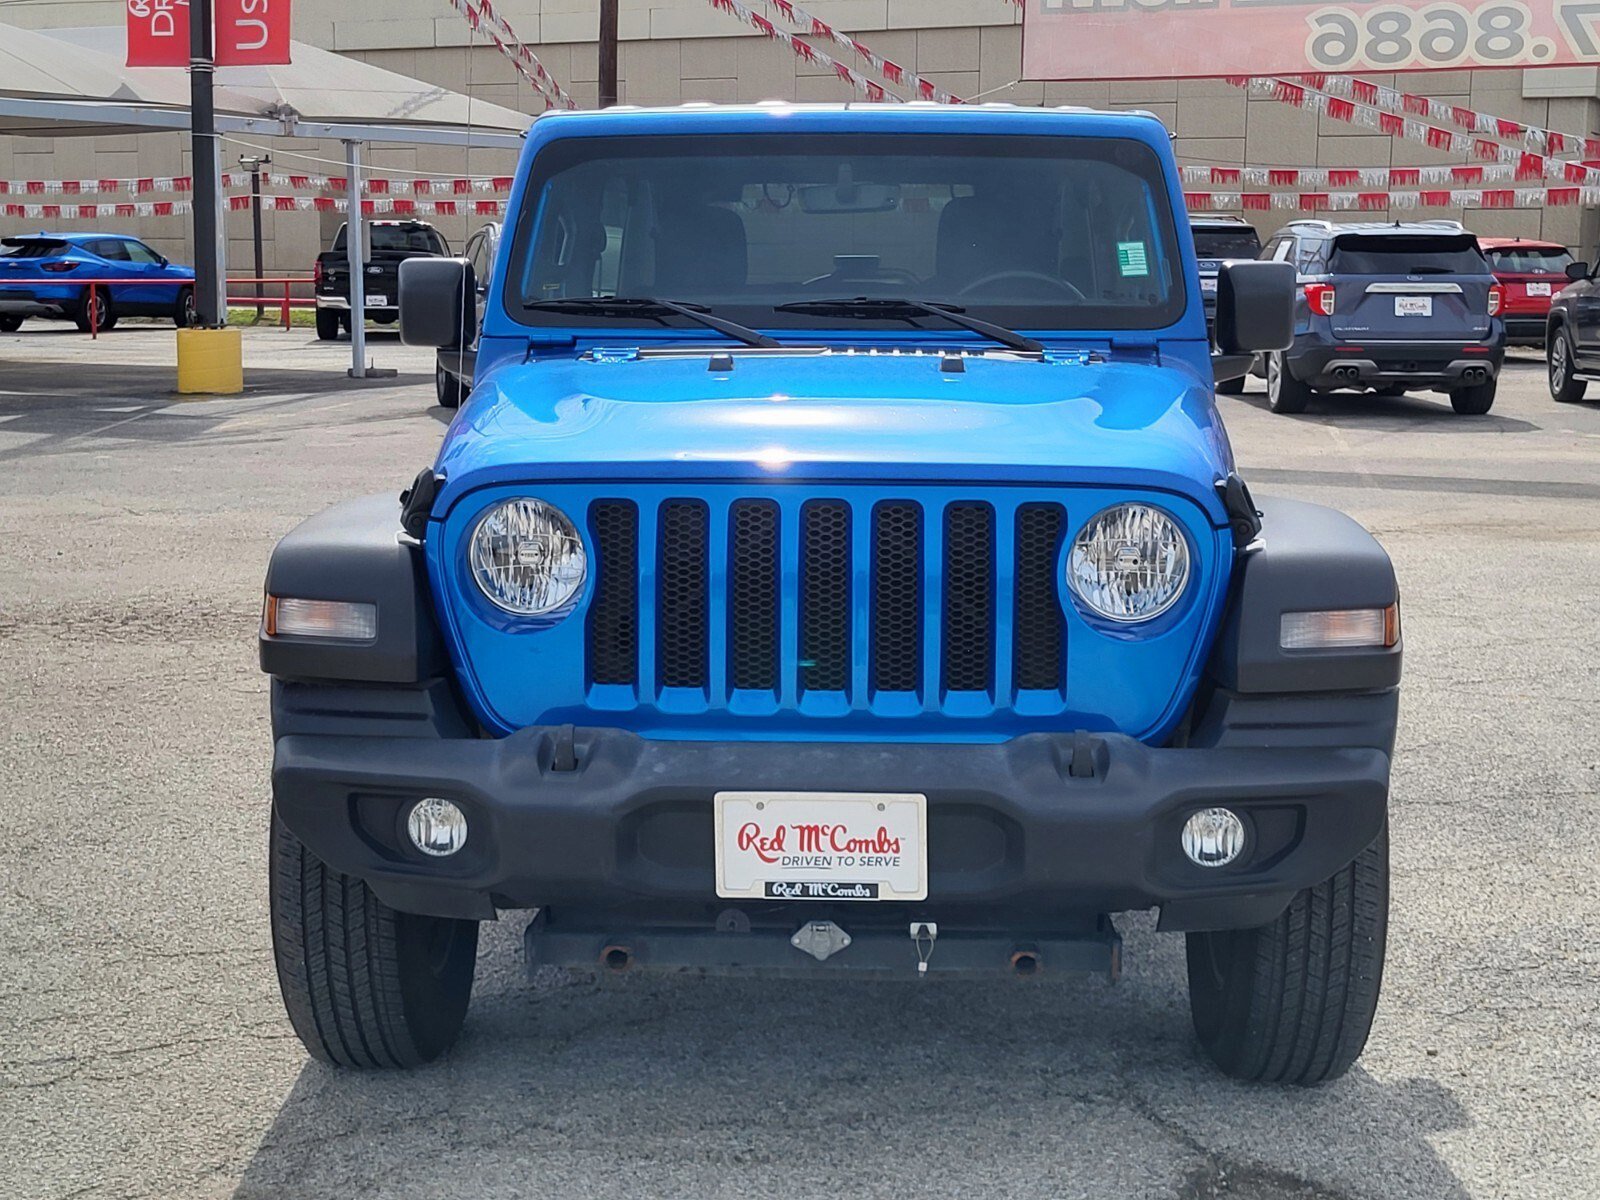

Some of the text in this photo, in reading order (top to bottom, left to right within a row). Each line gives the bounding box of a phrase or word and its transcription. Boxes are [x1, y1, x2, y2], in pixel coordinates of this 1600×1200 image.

[737, 821, 901, 863] Red McCombs
[781, 856, 901, 867] DRIVEN TO SERVE
[771, 881, 871, 898] Red McCombs
